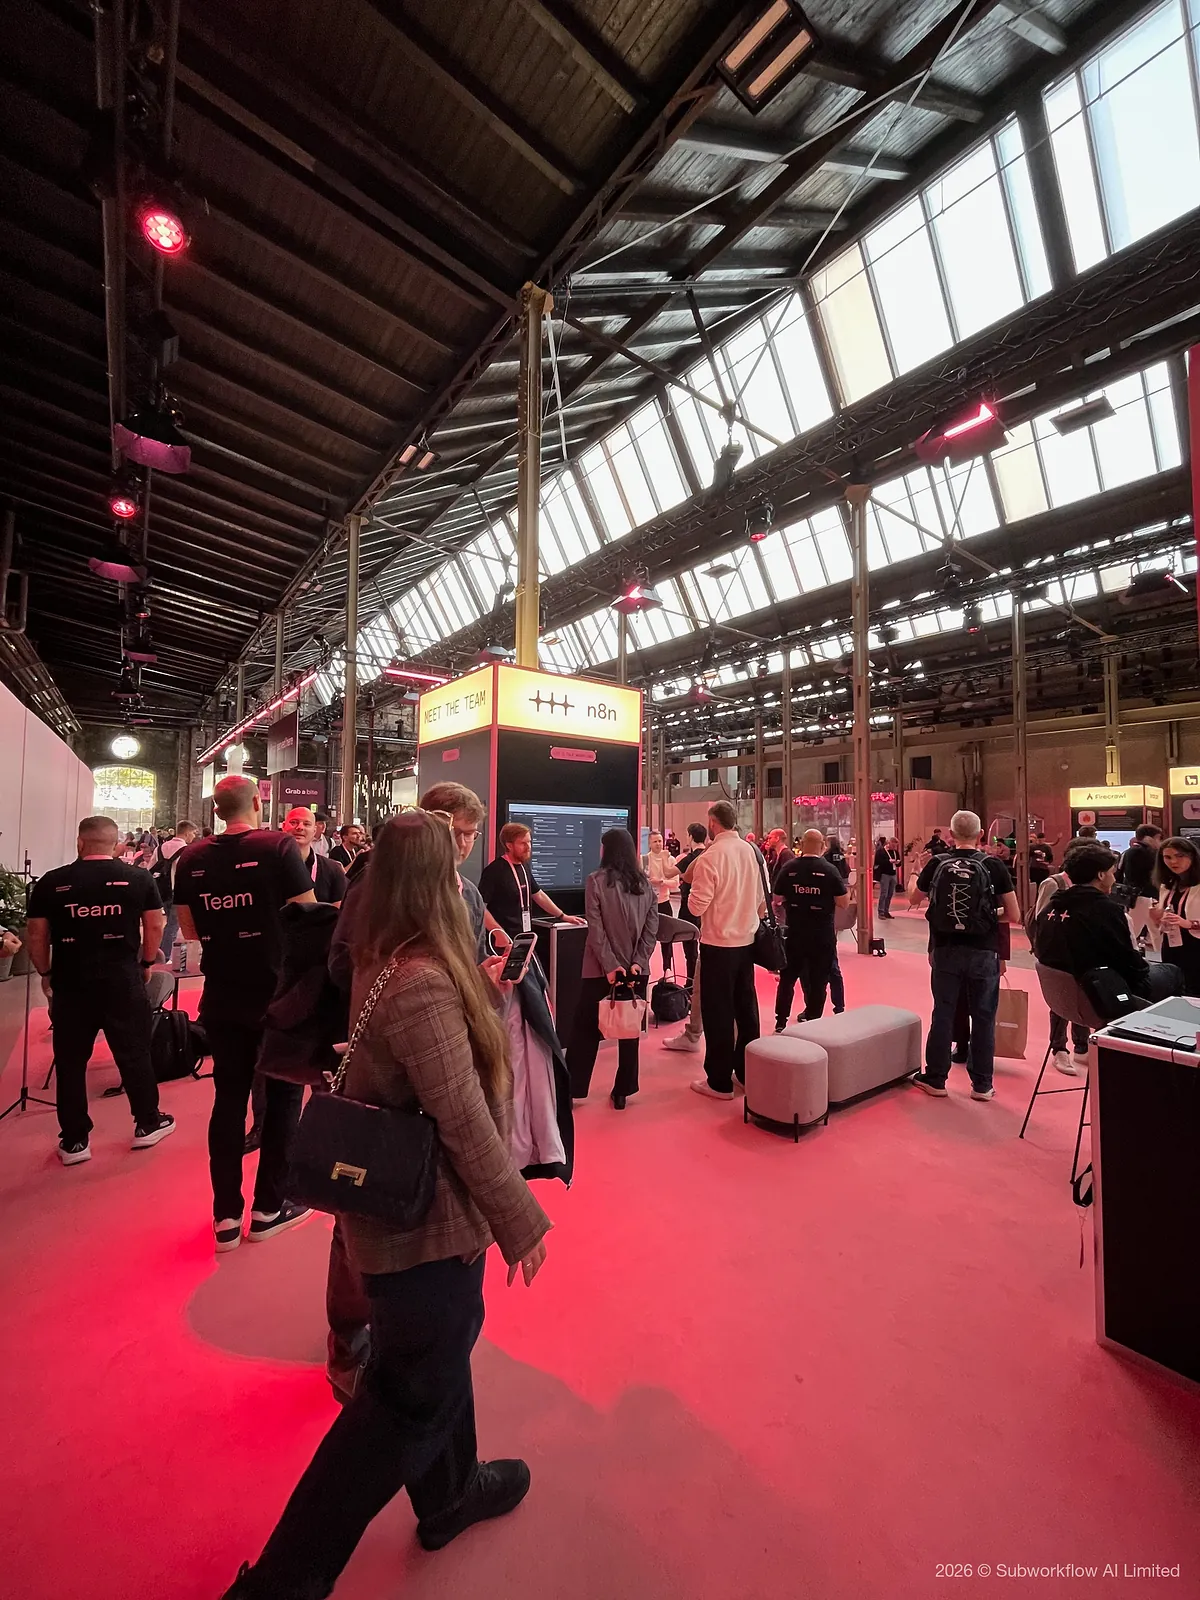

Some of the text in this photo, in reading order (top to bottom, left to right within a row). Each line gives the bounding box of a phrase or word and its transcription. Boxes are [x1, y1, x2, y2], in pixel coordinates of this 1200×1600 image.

[424, 690, 486, 724] MEET THE TEAM
[587, 703, 617, 721] n8n
[792, 884, 821, 895] Team
[64, 903, 122, 918] Team
[199, 892, 253, 911] Team
